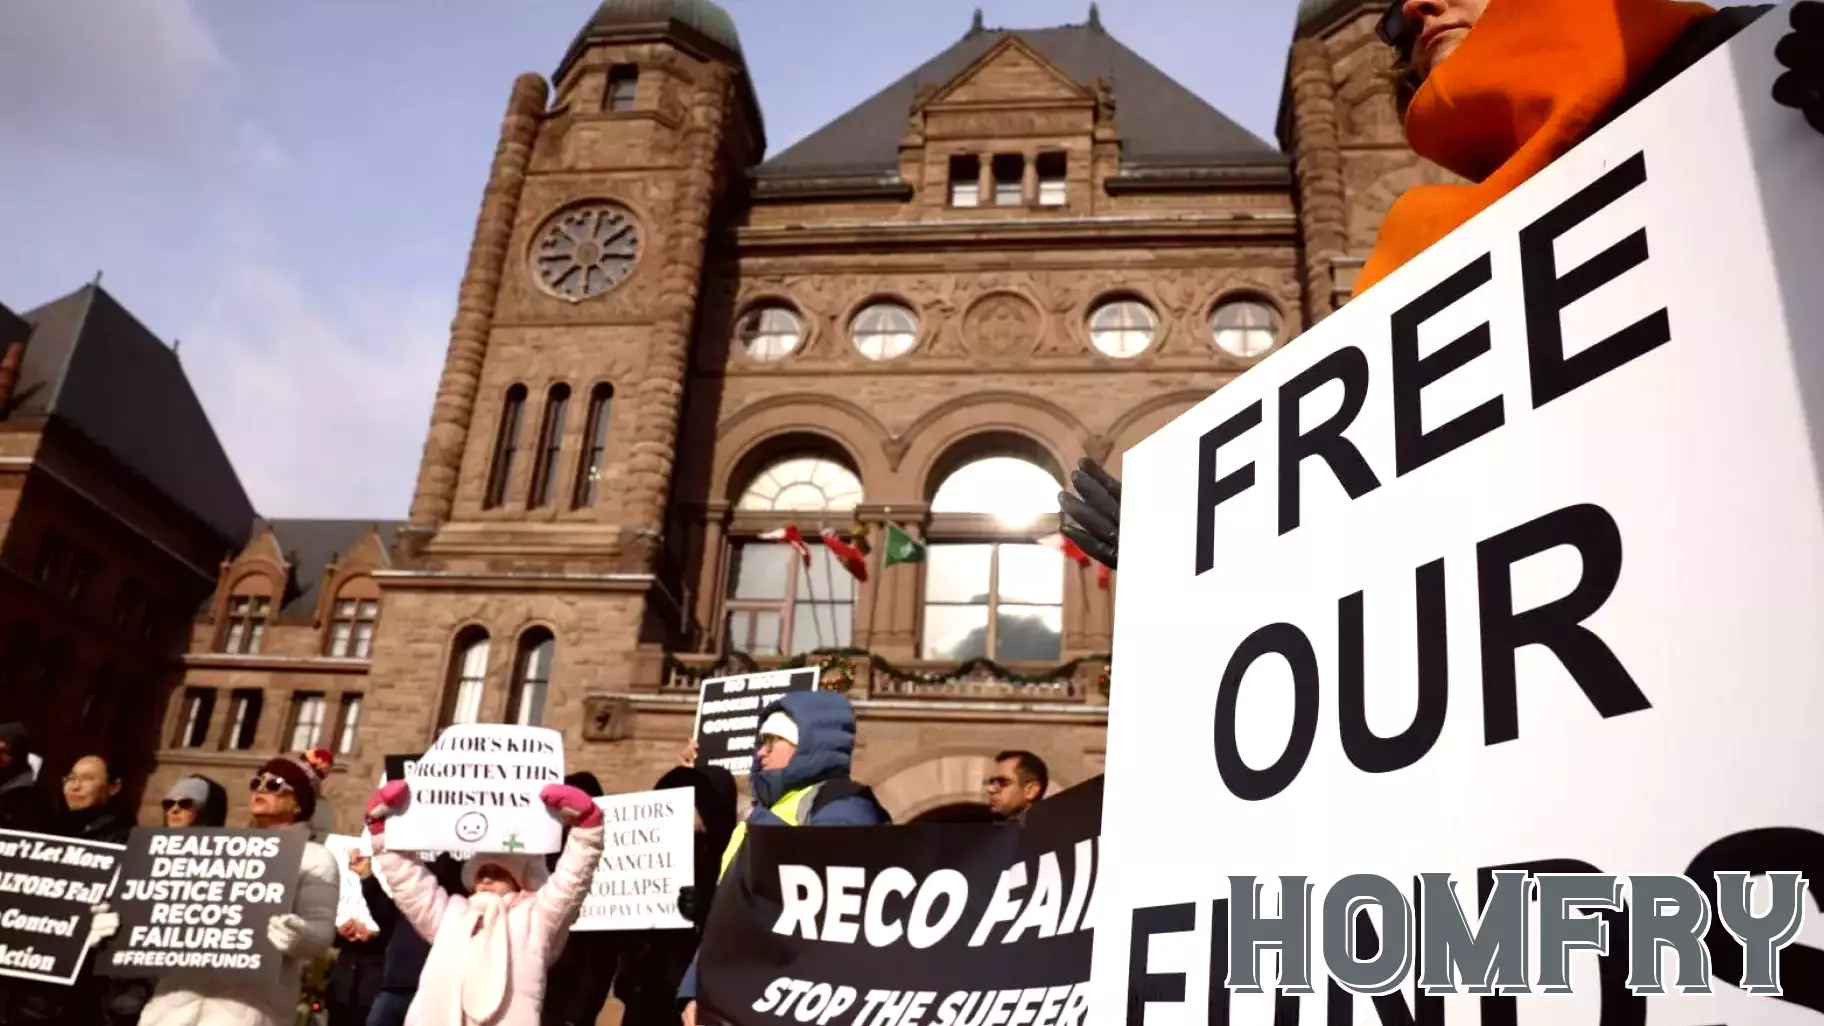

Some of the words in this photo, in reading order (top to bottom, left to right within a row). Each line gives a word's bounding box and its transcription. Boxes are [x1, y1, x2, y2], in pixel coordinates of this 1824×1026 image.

[1195, 150, 1671, 576] FREE
[1213, 503, 1653, 801] OUR
[507, 738, 554, 754] KIDS
[512, 764, 559, 781] THIS
[416, 788, 531, 808] CHRISTMAS
[28, 841, 64, 863] Let
[60, 845, 115, 870] More
[149, 835, 281, 858] REALTORS
[151, 857, 267, 880] DEMAND
[64, 881, 107, 904] Fall
[120, 879, 226, 902] JUSTICE
[229, 881, 285, 904] FOR
[150, 902, 243, 926] RECO'S
[609, 902, 632, 917] PAY
[772, 864, 968, 949] RECO
[1, 908, 80, 938] Control
[129, 925, 255, 951] FAILURES
[112, 951, 262, 970] #FREEOURFUNDS
[752, 977, 857, 1026] STOP
[853, 989, 938, 1026] THE
